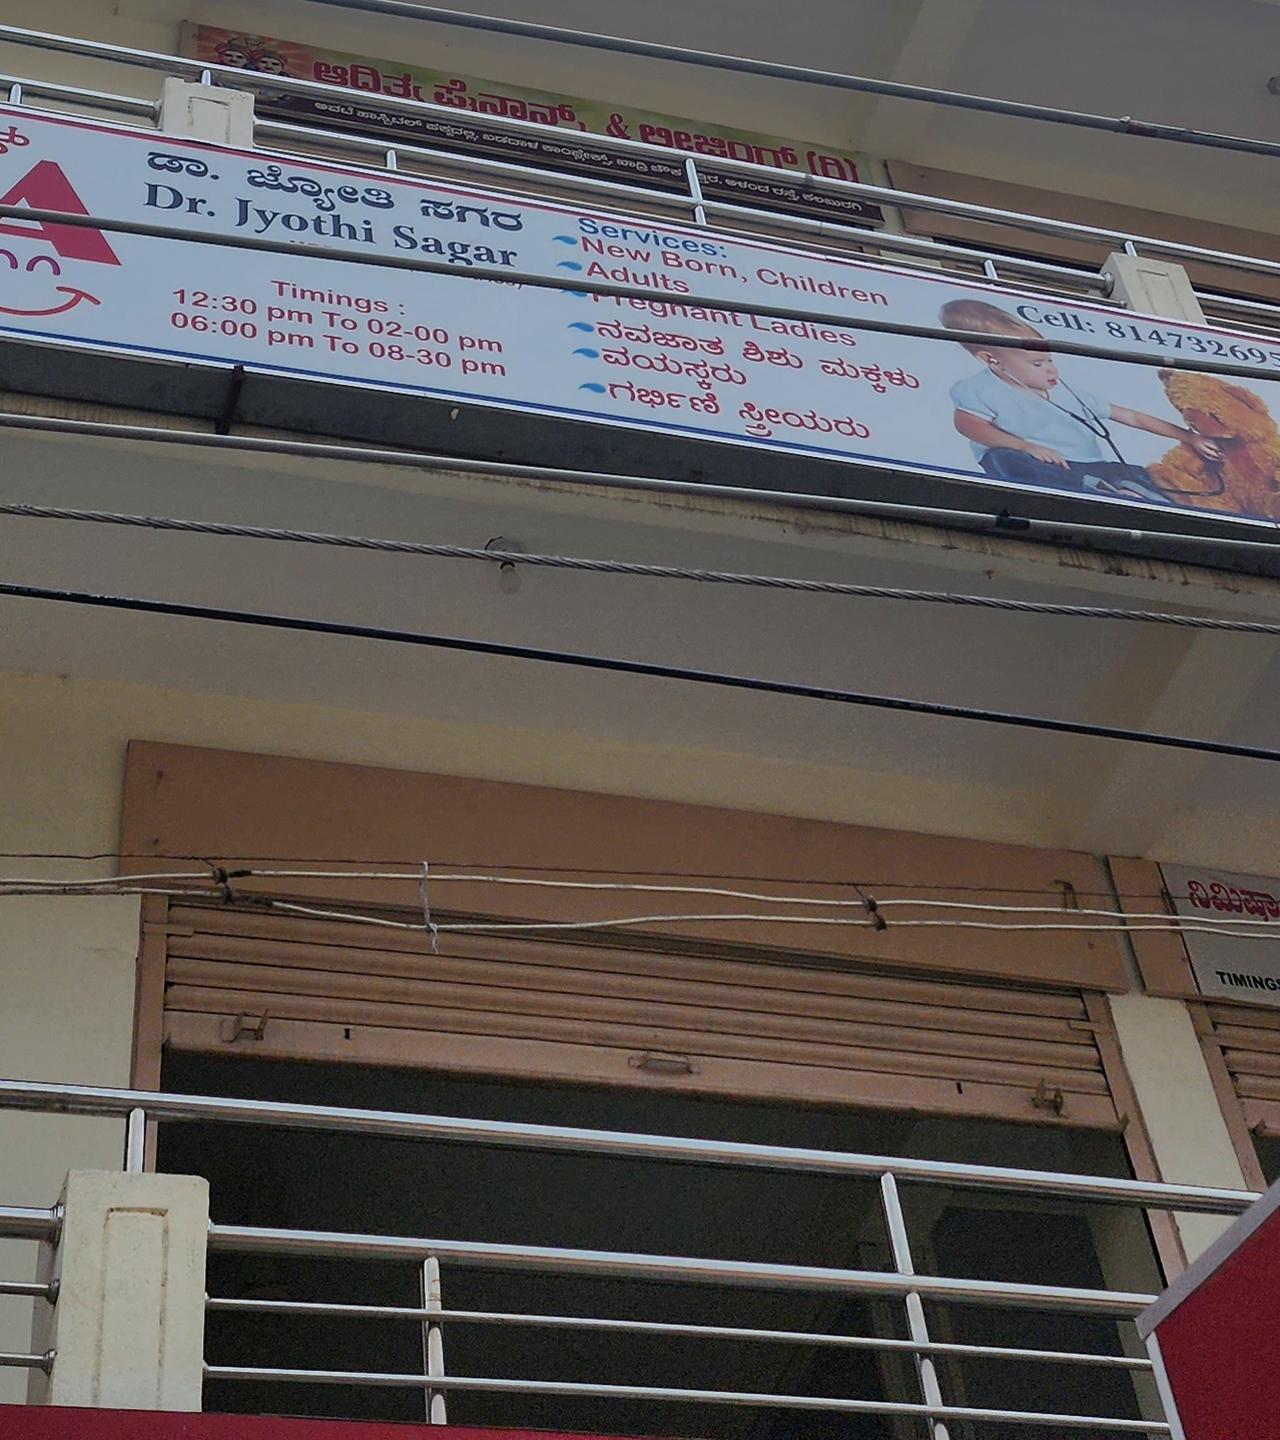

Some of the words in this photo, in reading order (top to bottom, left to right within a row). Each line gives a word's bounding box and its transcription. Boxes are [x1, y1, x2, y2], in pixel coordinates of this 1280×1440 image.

[605, 112, 633, 140] &
[146, 151, 219, 181] ಡಾ.
[247, 164, 396, 212] ಜ್ಯೋತಿ
[143, 181, 216, 217] Dr.
[234, 197, 377, 245] Jyothi
[393, 225, 518, 268] Sagar
[577, 217, 728, 258] Services:
[580, 235, 651, 263] New
[661, 250, 748, 283] Born,
[756, 268, 888, 306] Children
[586, 260, 690, 293] Adults
[271, 280, 389, 313] Timings
[172, 288, 258, 315] 12:30
[267, 307, 313, 324] pm
[322, 311, 358, 331] To
[367, 318, 449, 344] 02-00
[458, 334, 504, 353] pm
[752, 313, 857, 347] Ladies
[1016, 304, 1095, 334] Cell:
[170, 312, 258, 339] 06:00
[267, 329, 314, 348] pm
[322, 334, 360, 354] To
[368, 341, 452, 368] 08-30
[461, 358, 507, 376] pm
[597, 319, 725, 356] ನವಜಾತ
[741, 341, 803, 369] ಶಿಶು
[819, 358, 920, 393] ಮಕ್ಕಳು
[601, 346, 747, 390] ವಯಸ್ಕರು
